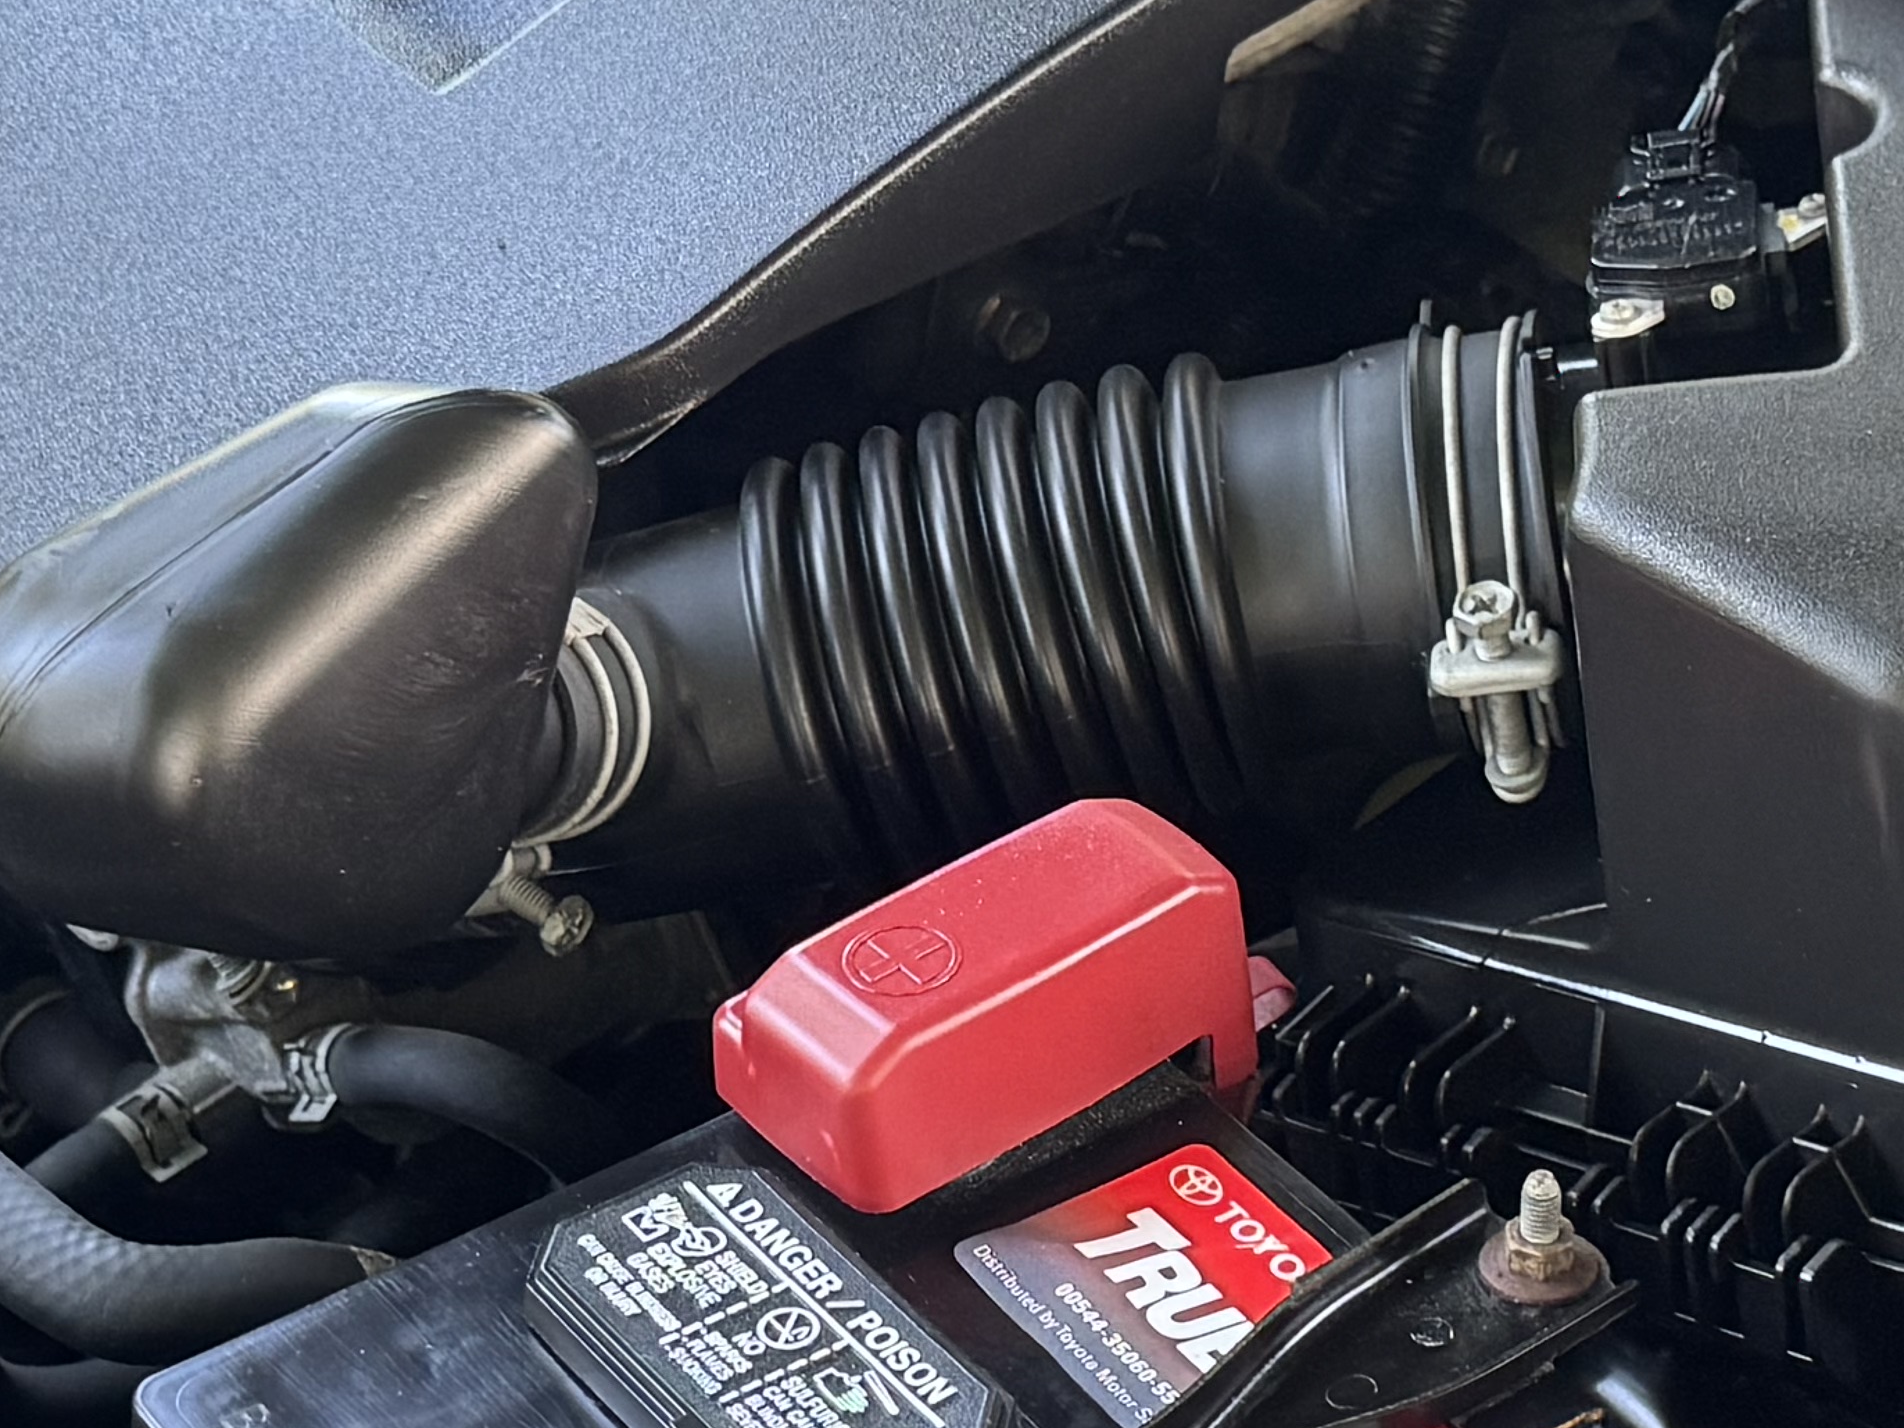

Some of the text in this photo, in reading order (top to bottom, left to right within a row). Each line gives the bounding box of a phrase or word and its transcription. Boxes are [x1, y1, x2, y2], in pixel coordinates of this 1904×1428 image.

[627, 1252, 675, 1293] GASES
[647, 1242, 721, 1309] EXPLOSIVE
[695, 1260, 742, 1298] EYES
[715, 1251, 768, 1294] SHIELD
[729, 1198, 843, 1299] DANGER
[846, 1310, 962, 1410] POISON
[732, 1331, 765, 1355] NO
[972, 1243, 1047, 1315] Distributed
[1034, 1308, 1058, 1335] by
[1055, 1326, 1098, 1373] Toyota
[1095, 1367, 1137, 1411] Motor
[668, 1347, 722, 1398] SMOKING
[686, 1338, 734, 1380] FLAMES
[703, 1331, 752, 1373] SPARKS
[763, 1386, 792, 1411] CAN
